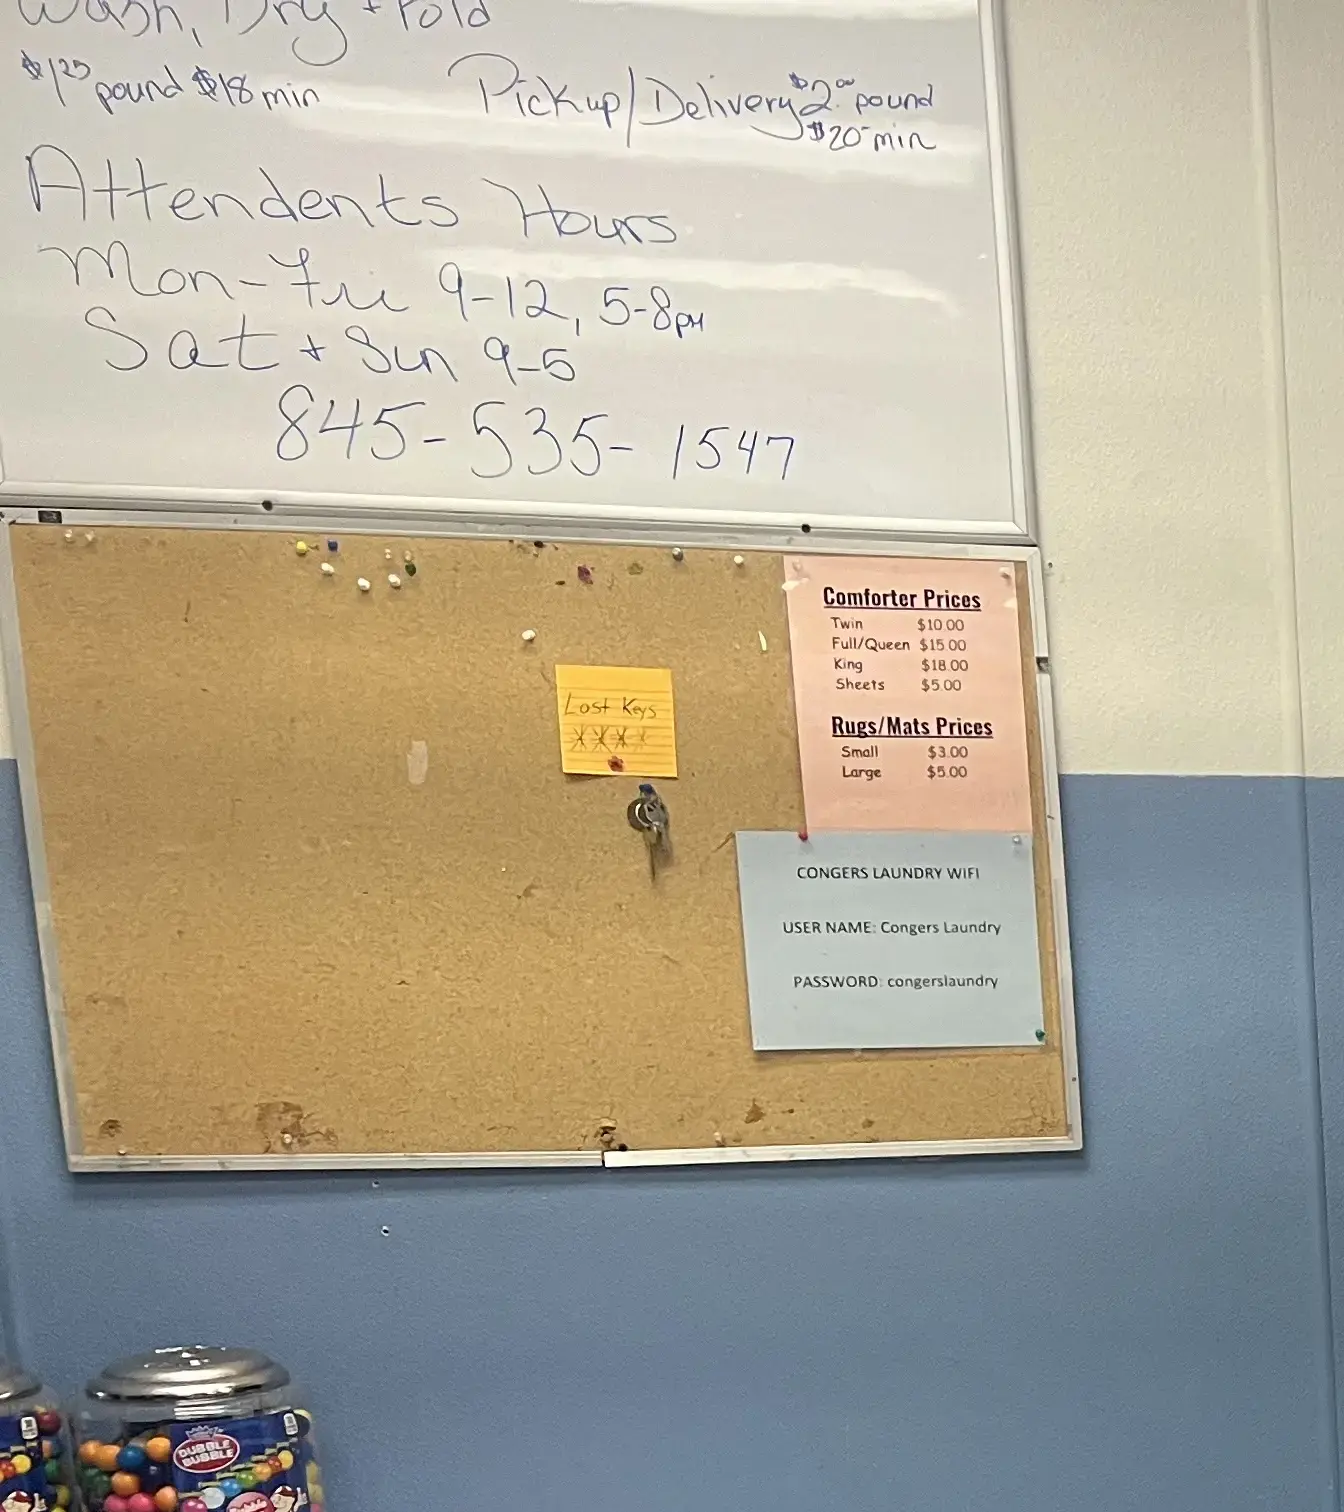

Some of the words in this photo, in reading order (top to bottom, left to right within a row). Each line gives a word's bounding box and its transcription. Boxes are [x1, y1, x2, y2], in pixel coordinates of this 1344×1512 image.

[94, 65, 184, 114] pound
[192, 65, 254, 107] $18
[263, 82, 321, 110] min
[856, 83, 933, 115] pound
[874, 122, 937, 152] min
[25, 144, 459, 229] Attendents
[482, 177, 678, 244] Hours
[84, 306, 280, 372] Sat
[343, 324, 459, 382] Sun
[823, 586, 917, 608] Comforter
[924, 588, 981, 609] Prices
[831, 617, 863, 630] Twin
[917, 618, 965, 632] $10.00
[832, 637, 910, 652] Full/Queen
[919, 638, 966, 652] $15.00
[834, 658, 863, 673] King
[921, 658, 969, 672] $18.00
[836, 678, 885, 691] Sheets
[921, 678, 962, 692] $5.00
[565, 692, 610, 715] Lost
[622, 696, 657, 721] Keys
[831, 716, 930, 739] Rugs/Mats
[936, 717, 993, 737] Prices
[842, 746, 879, 758] Small
[928, 746, 968, 759] $3.00
[842, 766, 881, 781] Large
[927, 765, 968, 779] $5.00
[797, 866, 868, 879] CONGERS
[873, 867, 942, 880] LAUNDRY
[946, 867, 980, 880] WIFI
[782, 921, 821, 934] USER
[825, 921, 876, 934] NAME:
[881, 921, 939, 936] Congers
[944, 921, 1001, 936] Laundry
[793, 975, 882, 988] PASSWORD:
[887, 975, 998, 990] congerslaundry
[178, 1439, 232, 1458] DUBBLE
[182, 1449, 234, 1467] BUBBLE
